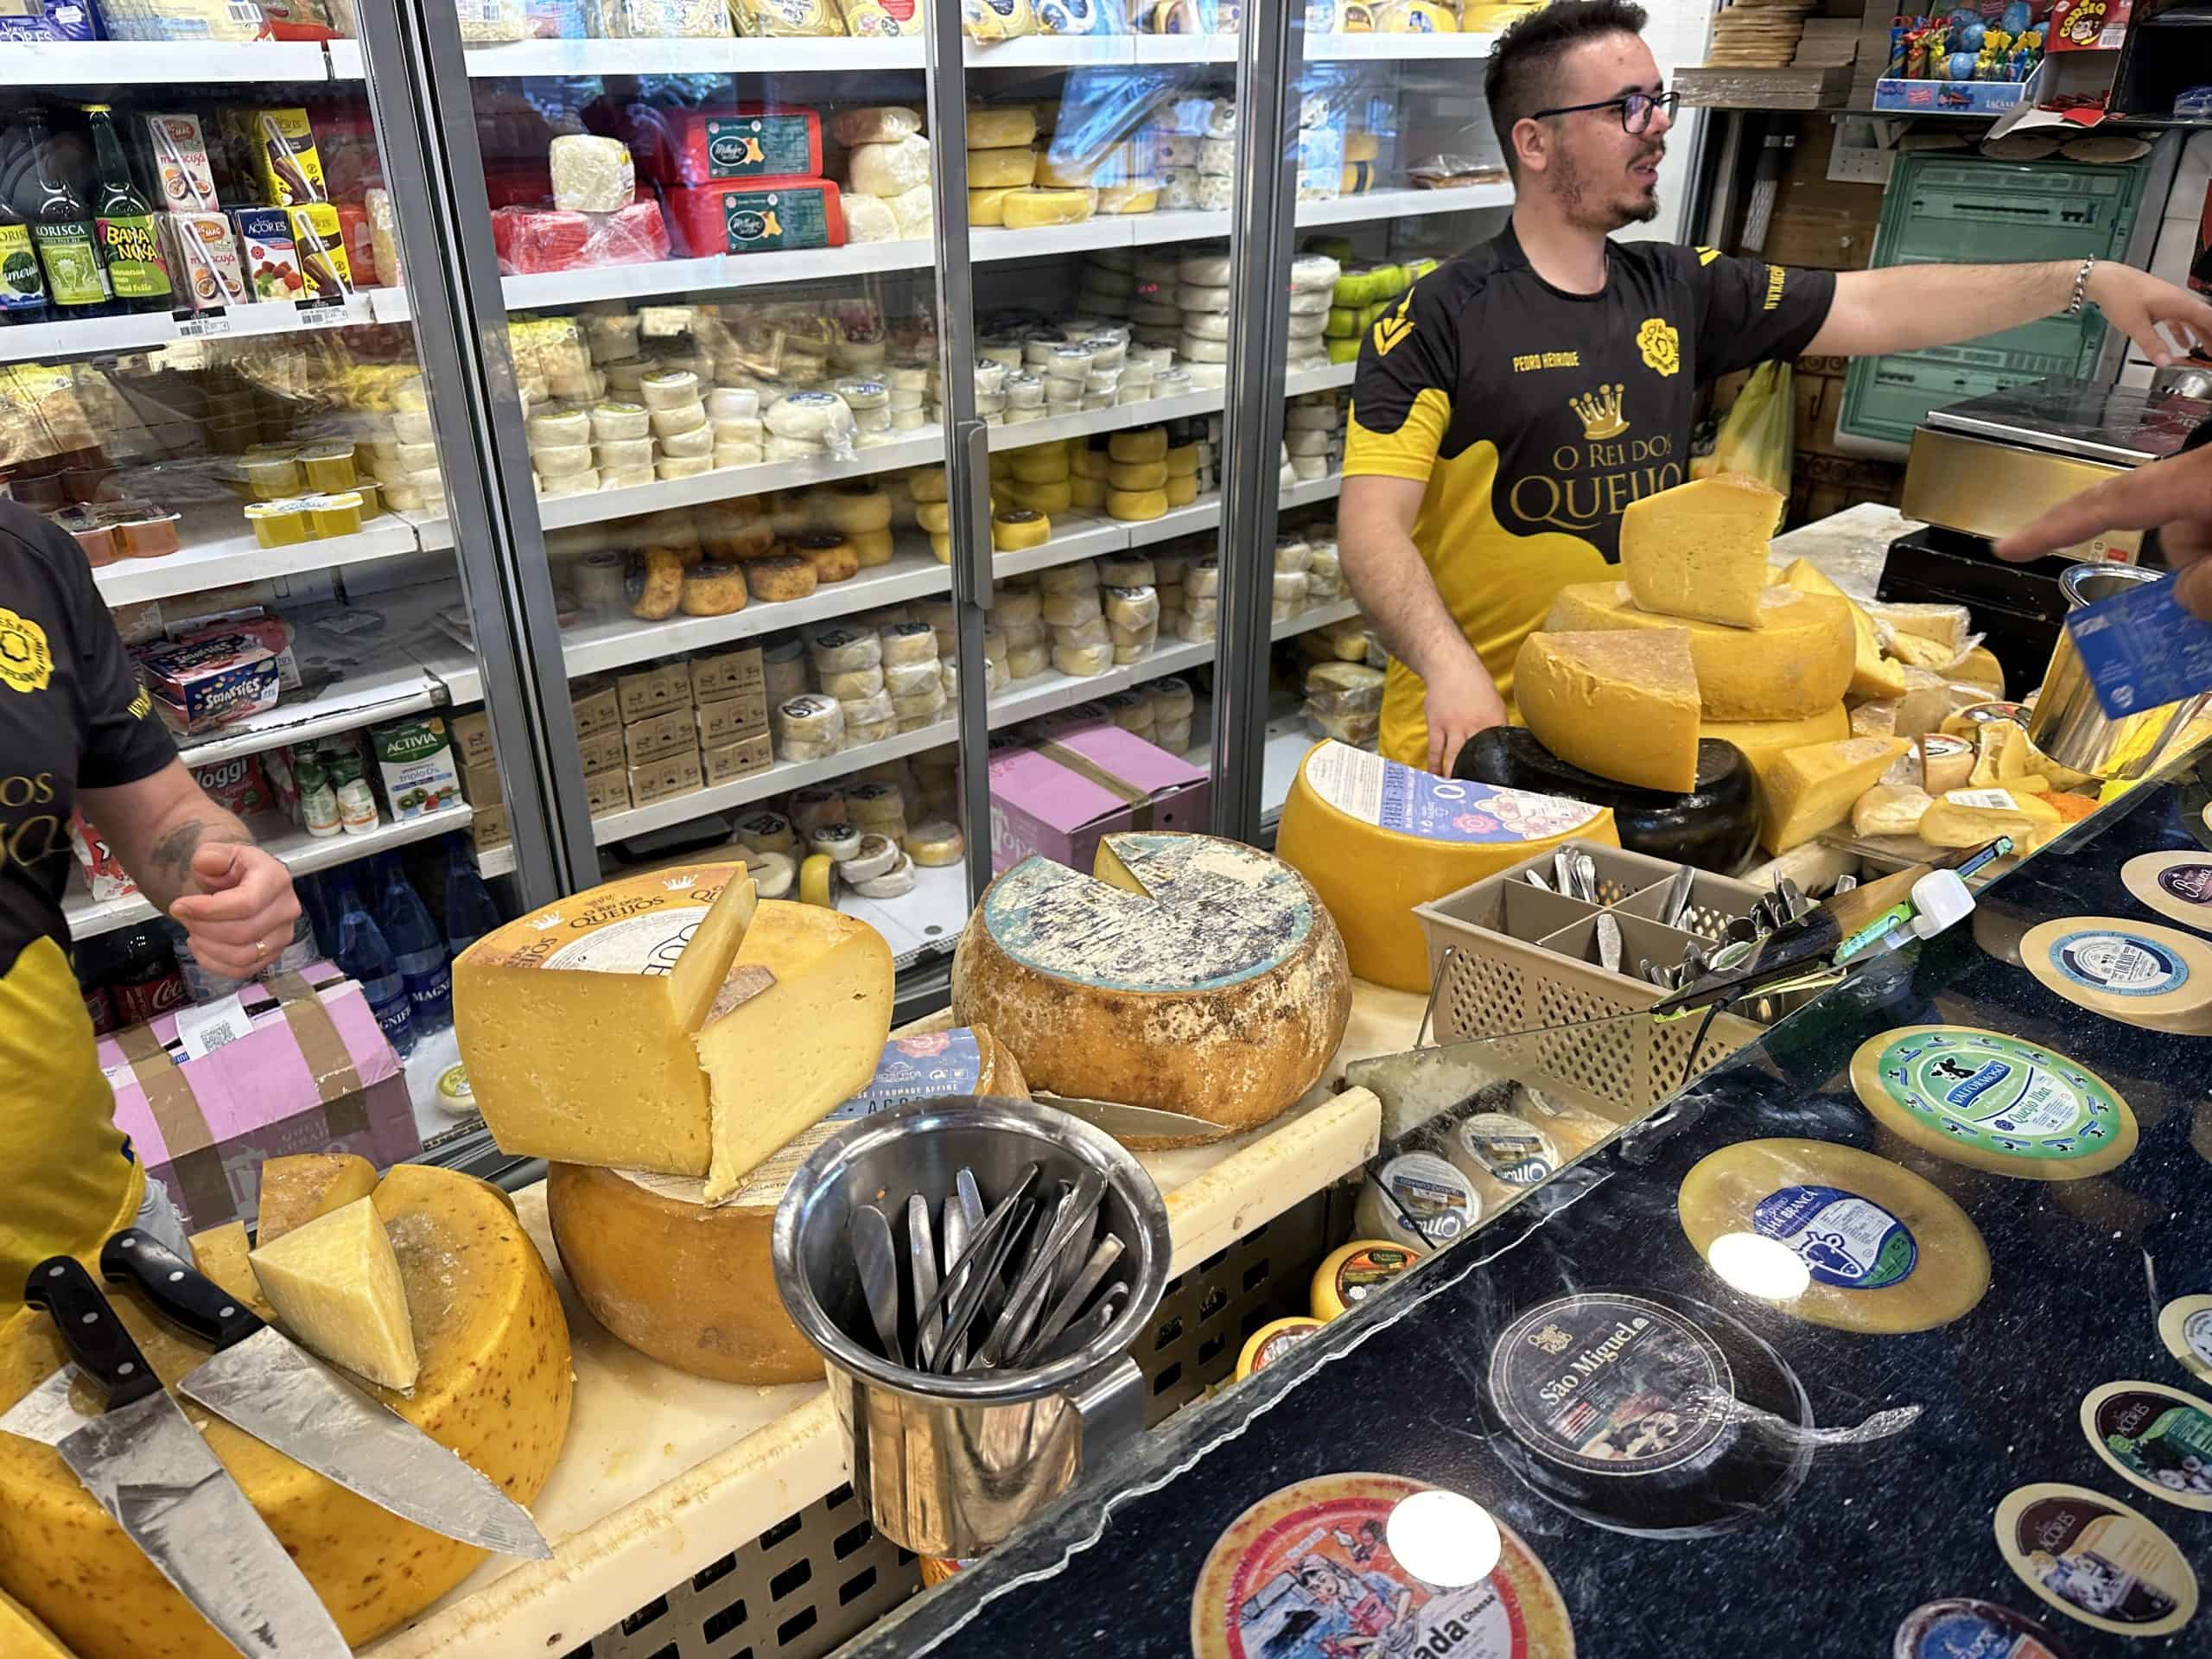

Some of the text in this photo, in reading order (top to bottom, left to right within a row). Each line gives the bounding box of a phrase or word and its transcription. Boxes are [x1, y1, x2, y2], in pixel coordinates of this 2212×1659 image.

[1553, 446, 1579, 471] O
[1589, 442, 1625, 468] REI
[387, 733, 437, 754] ACTIVIA
[569, 895, 664, 929] QUEIJOS
[1540, 1375, 1579, 1405] São
[1570, 1321, 1639, 1376] Miguel
